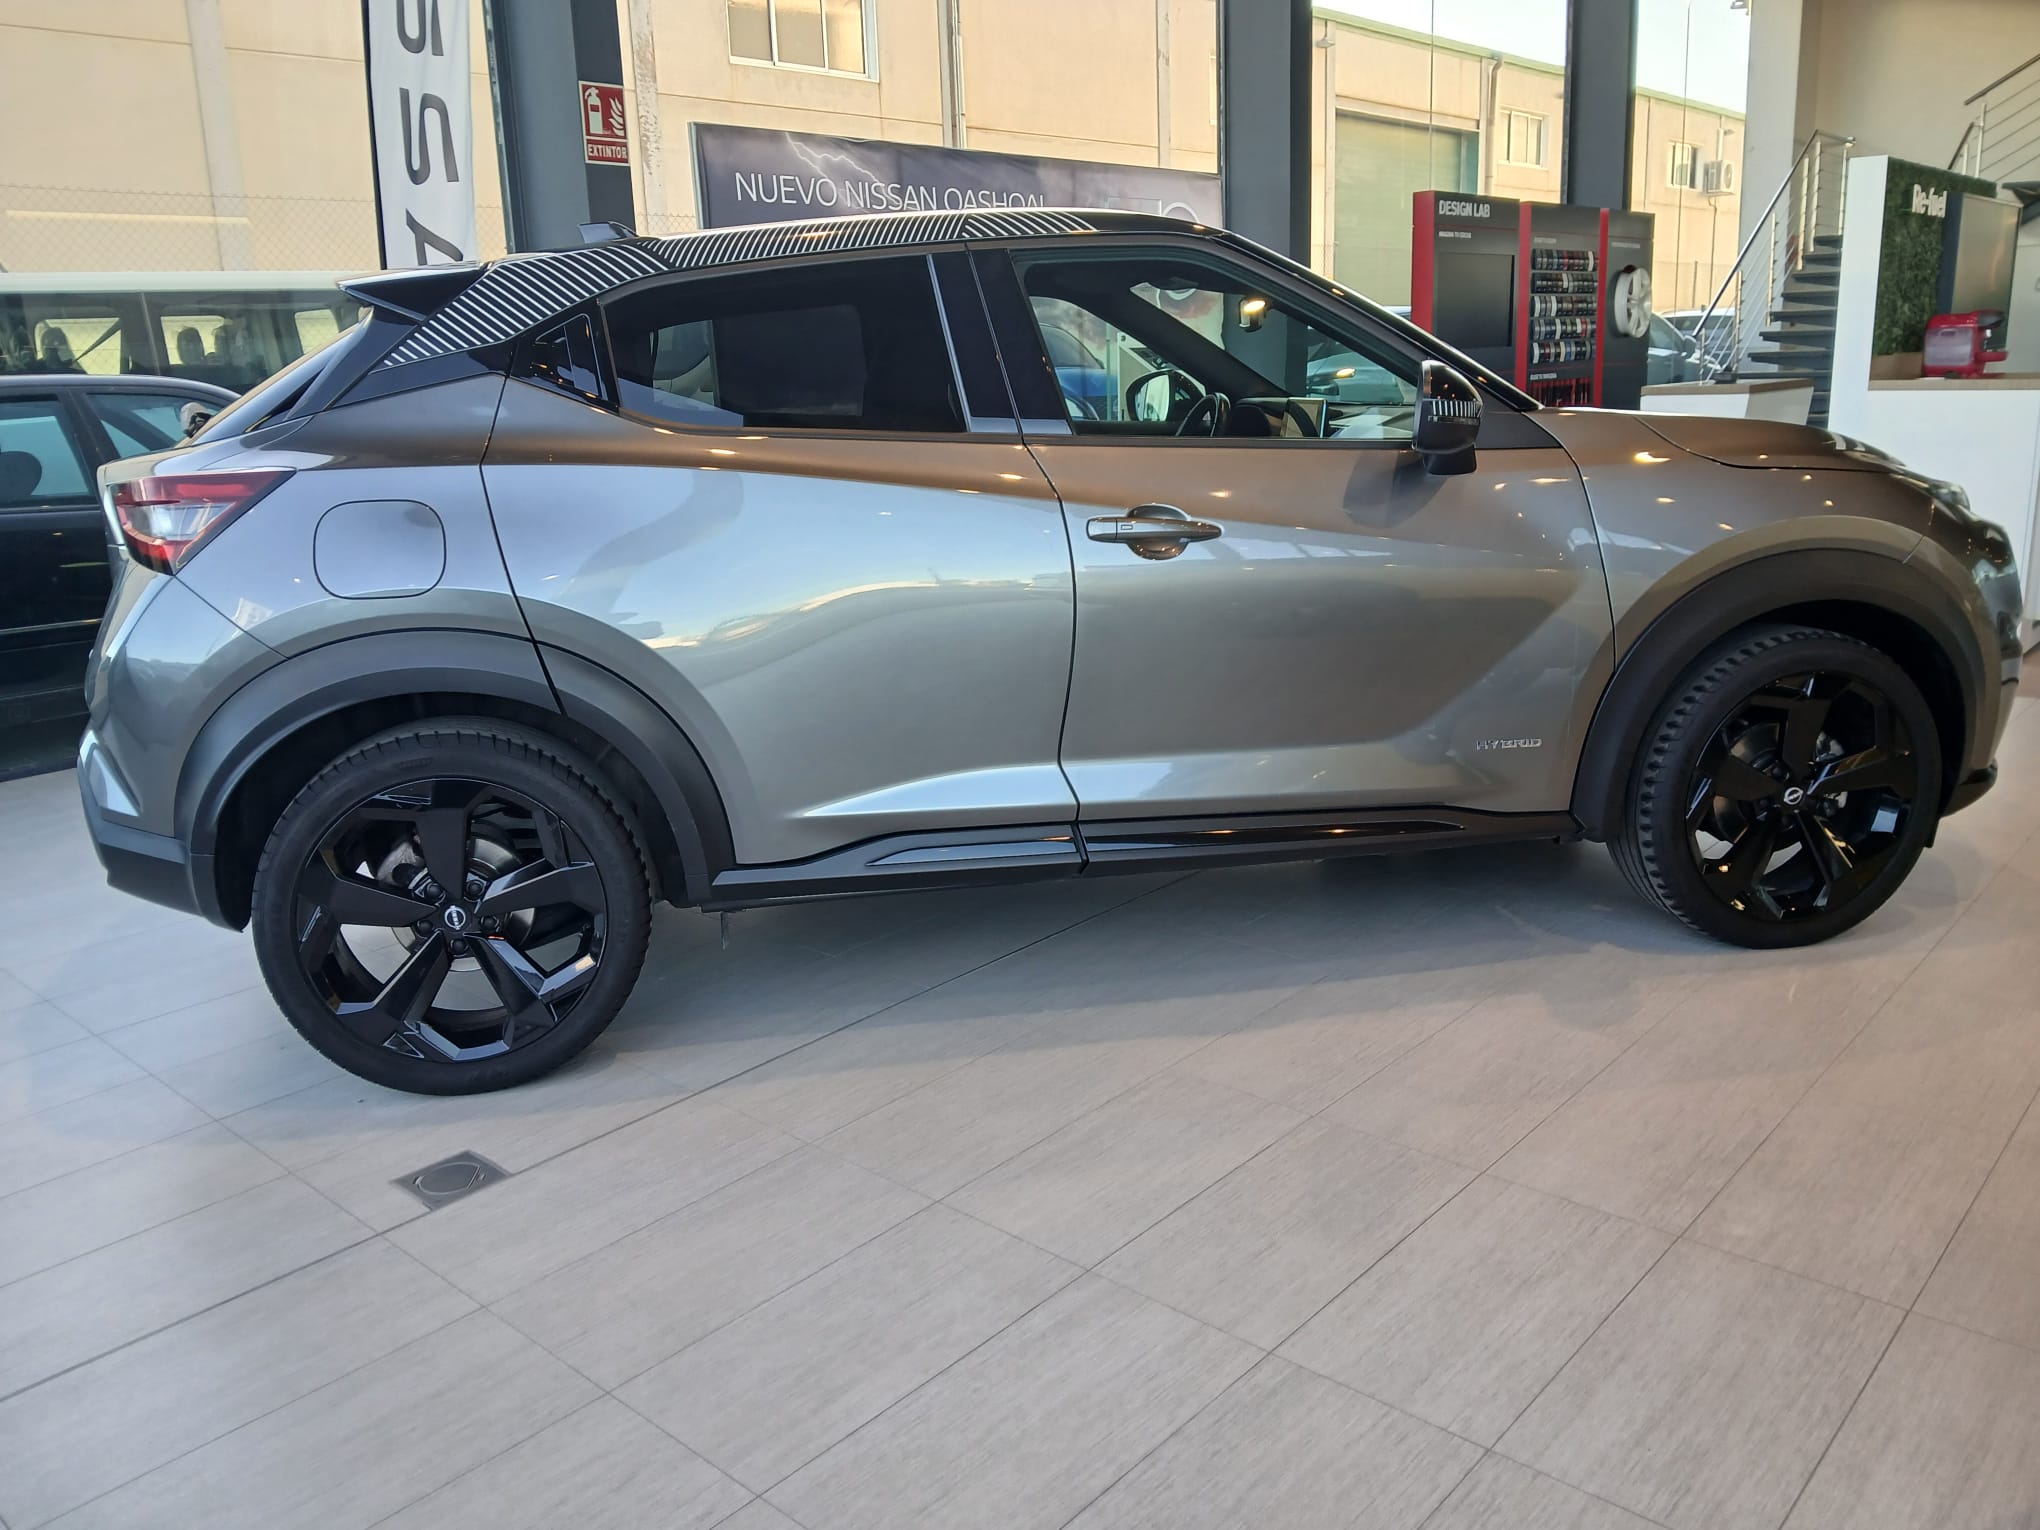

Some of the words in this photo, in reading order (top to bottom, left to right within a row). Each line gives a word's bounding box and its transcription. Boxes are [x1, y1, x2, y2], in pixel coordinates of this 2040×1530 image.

[587, 143, 628, 159] EXTINTOR
[735, 172, 838, 207] NUEVO
[844, 180, 938, 211] NISSAN
[1911, 183, 1948, 218] Re-fuel
[1438, 199, 1473, 217] DESIGN
[1473, 202, 1491, 218] LAB
[1476, 738, 1542, 750] HYBRID
